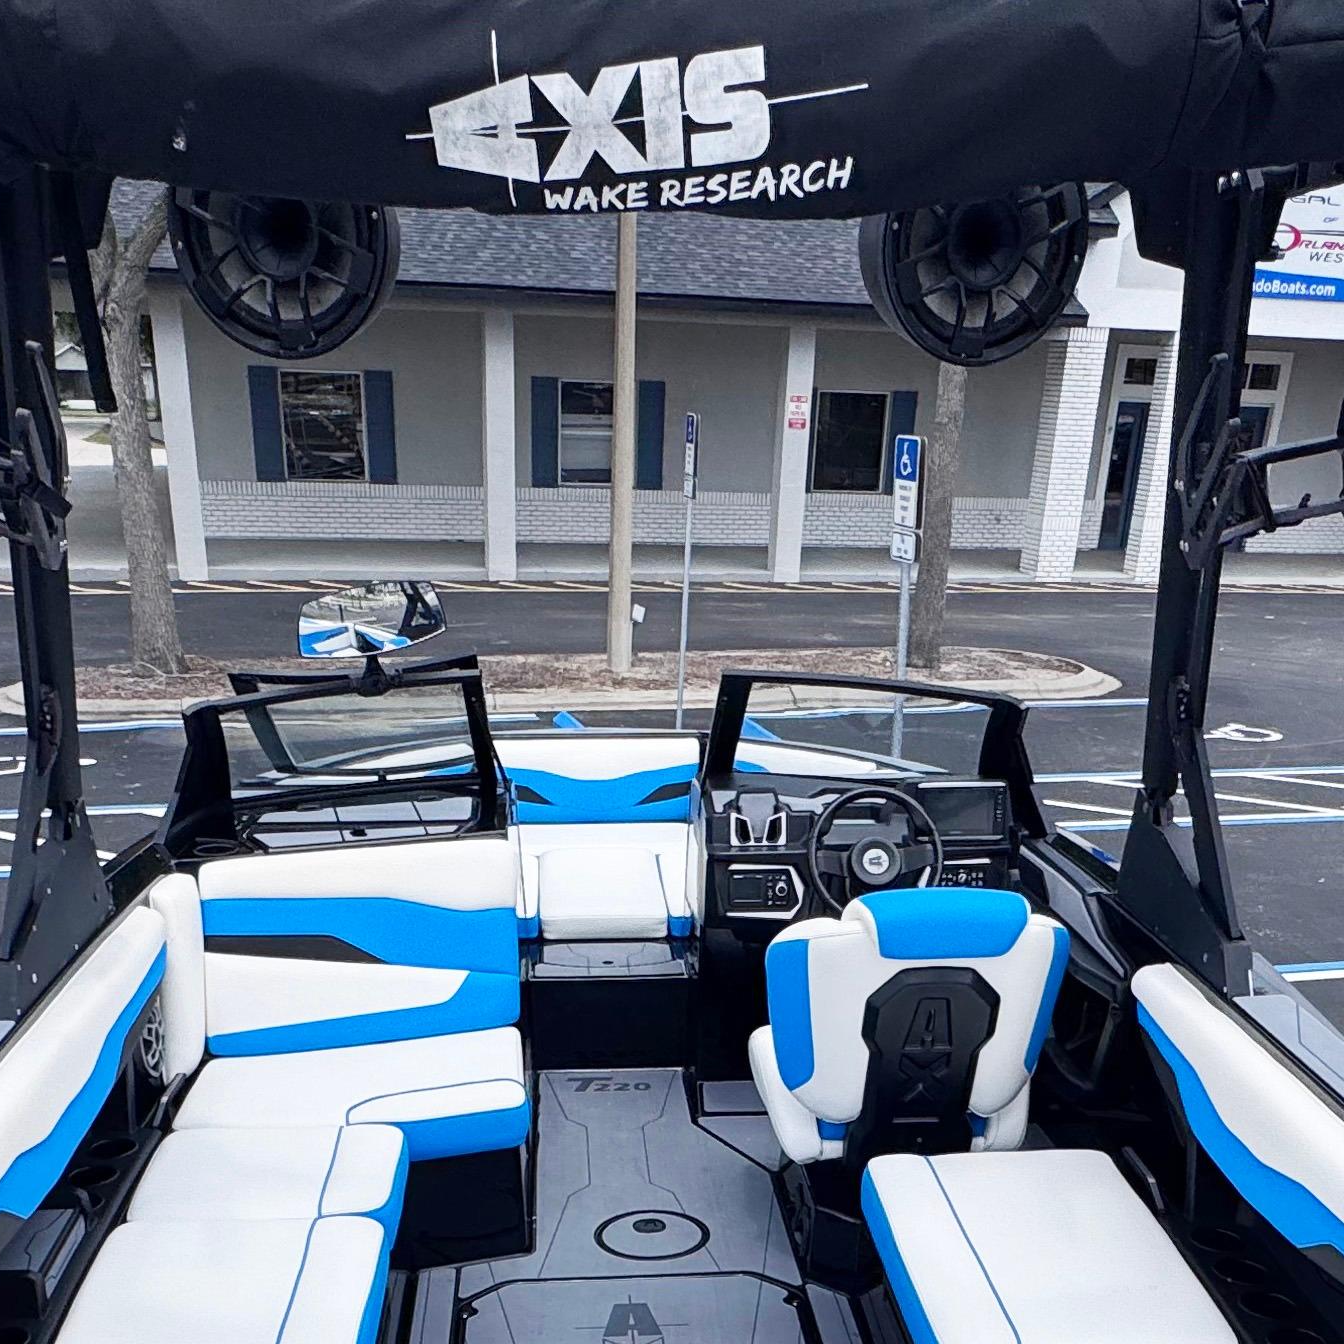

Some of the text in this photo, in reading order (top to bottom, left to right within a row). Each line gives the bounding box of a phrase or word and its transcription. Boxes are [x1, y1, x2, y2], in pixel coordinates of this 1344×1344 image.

[429, 45, 770, 183] AXIS
[543, 156, 855, 213] WAKE RESEARCH
[567, 1077, 651, 1093] T220
